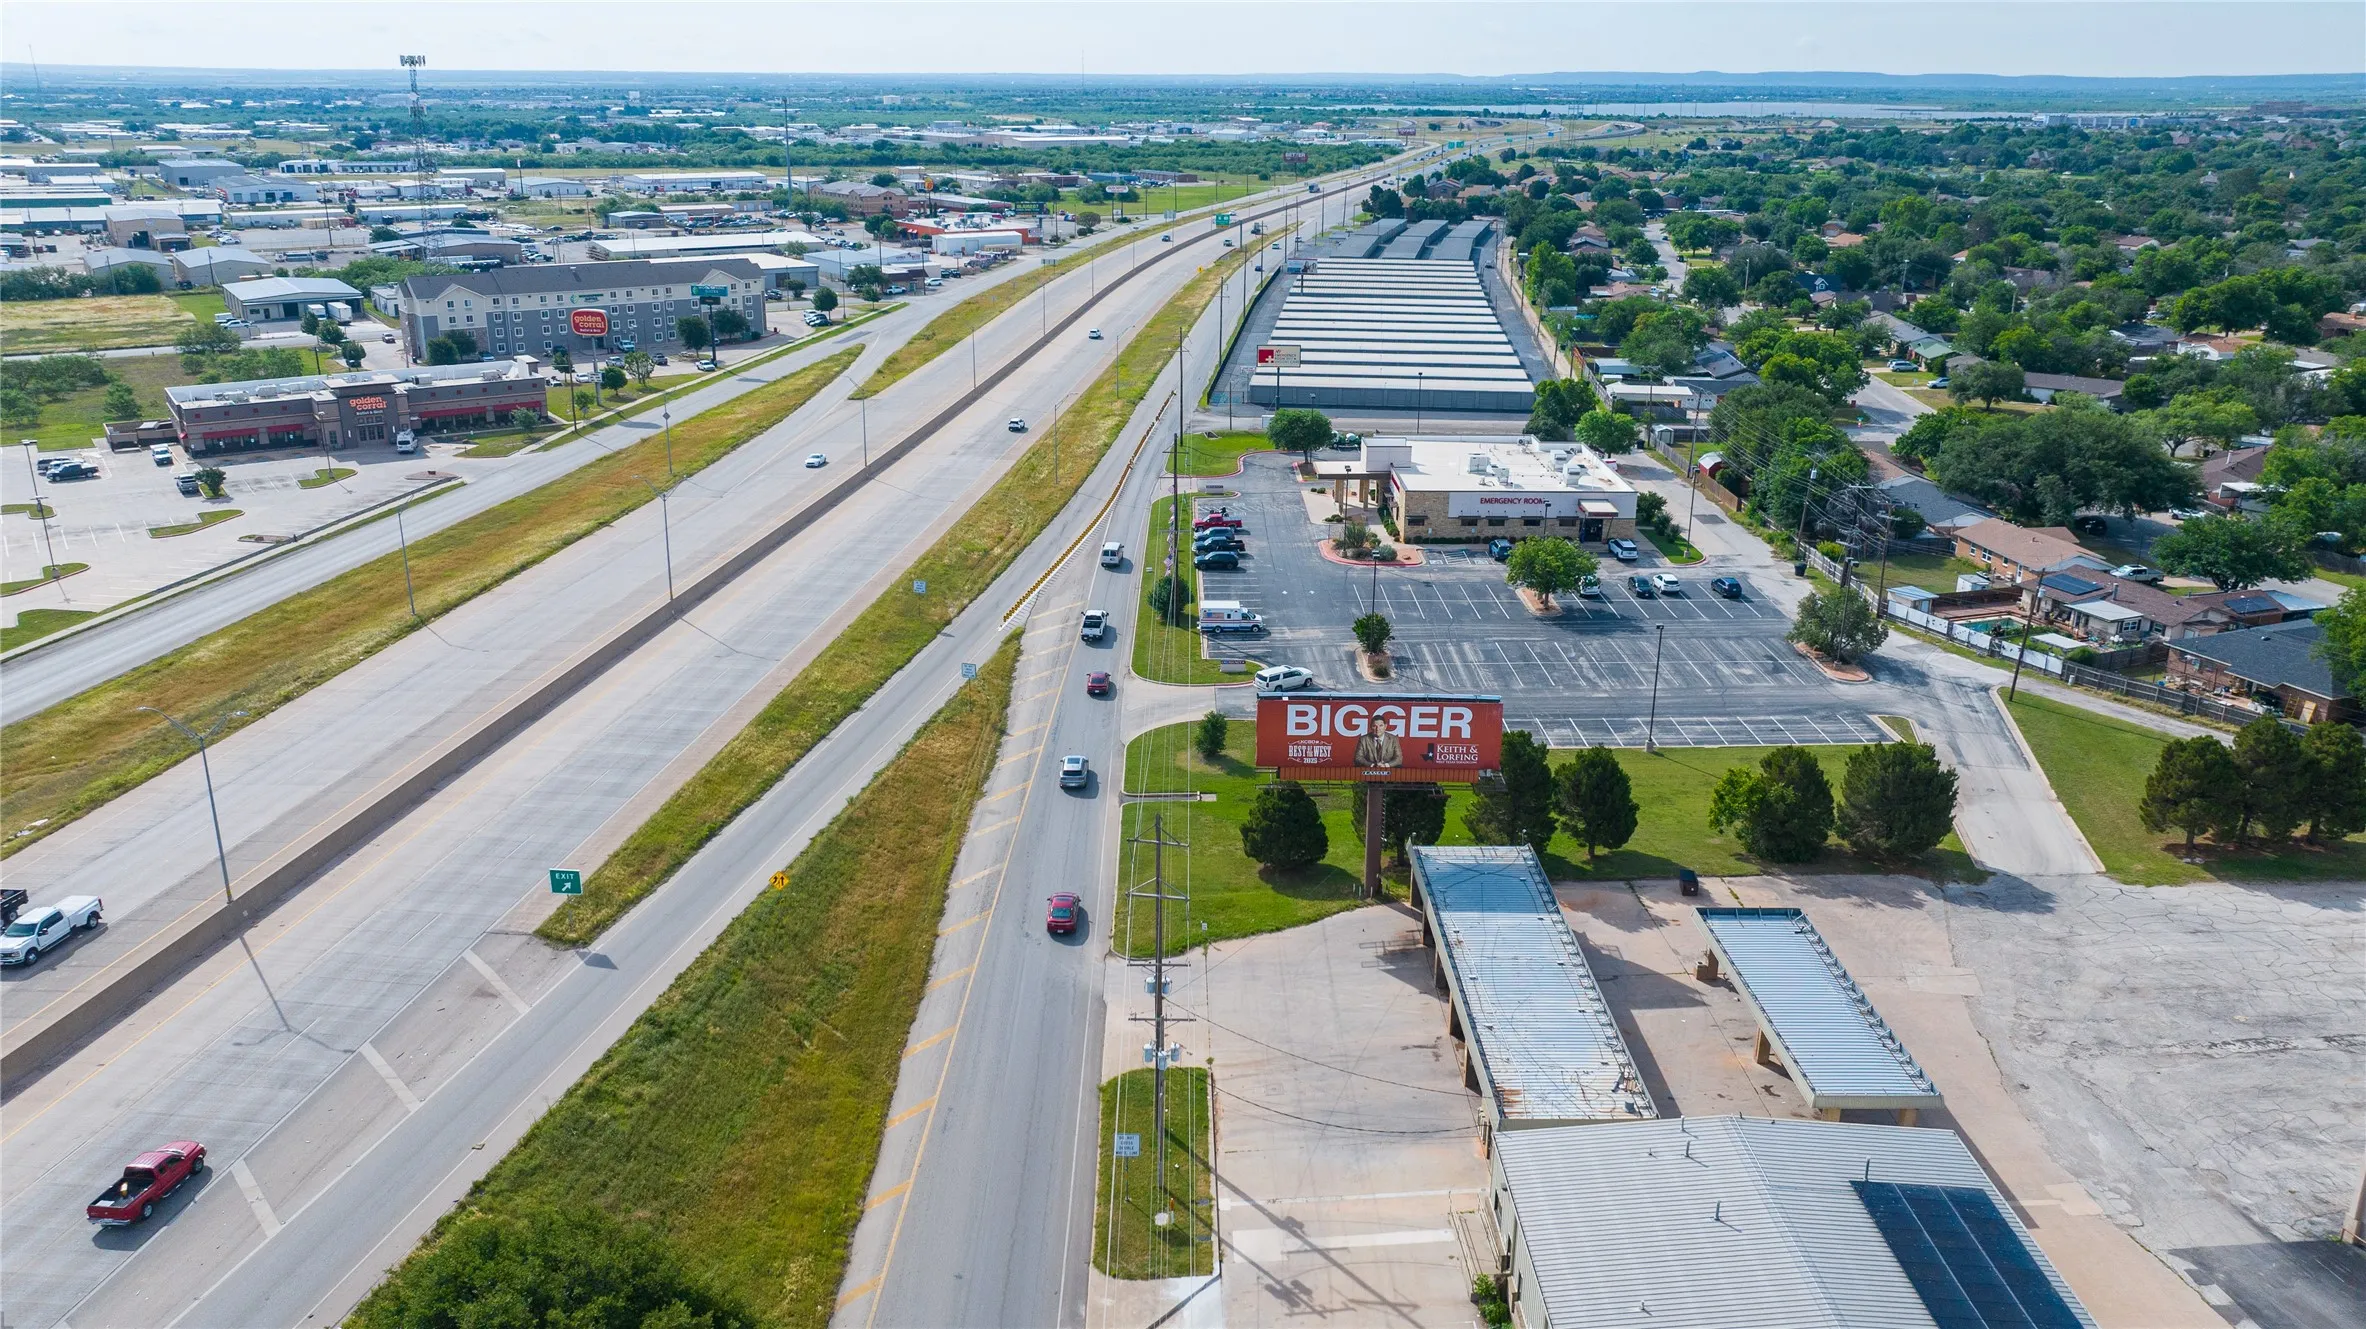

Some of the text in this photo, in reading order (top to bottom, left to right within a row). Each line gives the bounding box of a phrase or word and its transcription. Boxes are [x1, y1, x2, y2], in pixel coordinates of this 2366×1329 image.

[574, 315, 602, 324] golden
[579, 321, 605, 329] corral
[349, 396, 382, 407] golden
[356, 401, 388, 411] corral
[1287, 704, 1473, 739] BIGGER
[1288, 745, 1306, 757] BEST
[1313, 745, 1332, 758] WEST
[1437, 744, 1478, 754] KEITH &
[1436, 752, 1478, 761] LORFING
